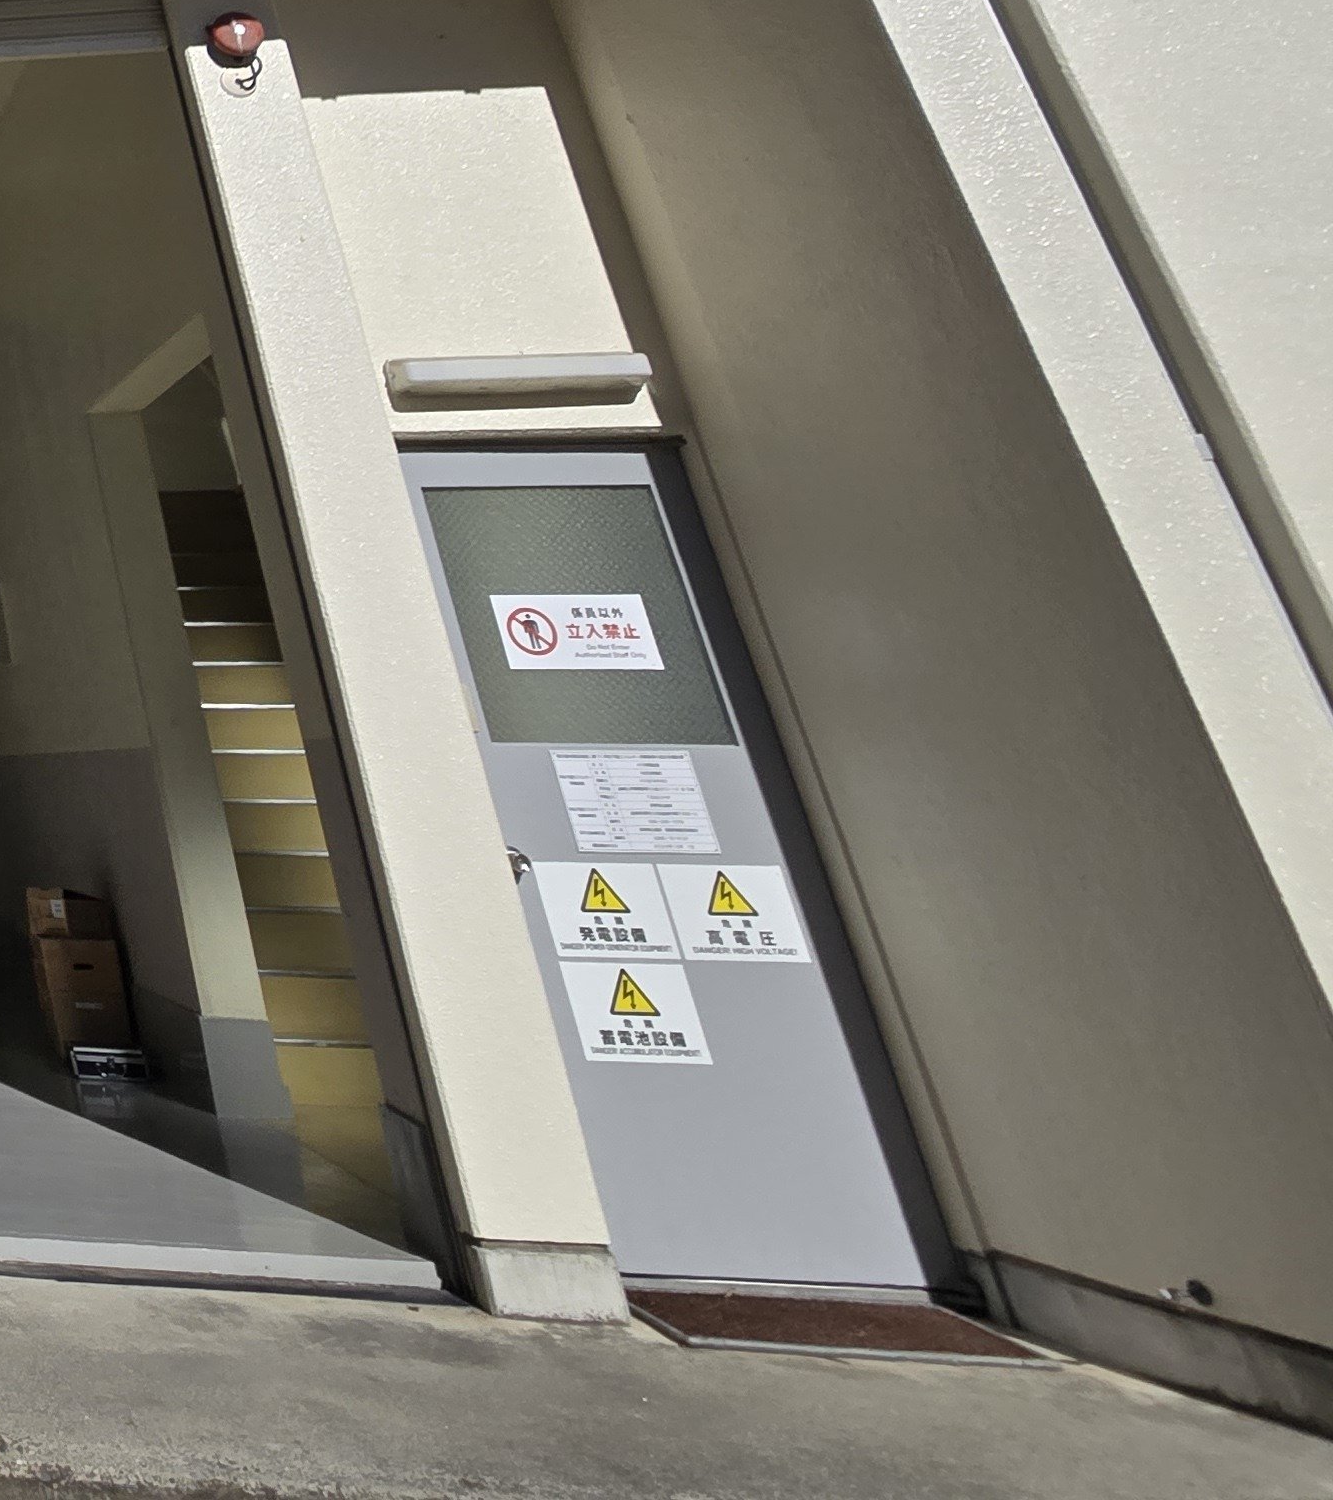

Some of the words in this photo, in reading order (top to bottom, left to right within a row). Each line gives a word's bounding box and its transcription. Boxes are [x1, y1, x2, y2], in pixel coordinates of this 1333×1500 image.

[565, 623, 641, 640] 立入禁止
[579, 926, 648, 943] 発電設備
[705, 930, 777, 946] 高電圧
[599, 1029, 687, 1047] 蓄電池設備
